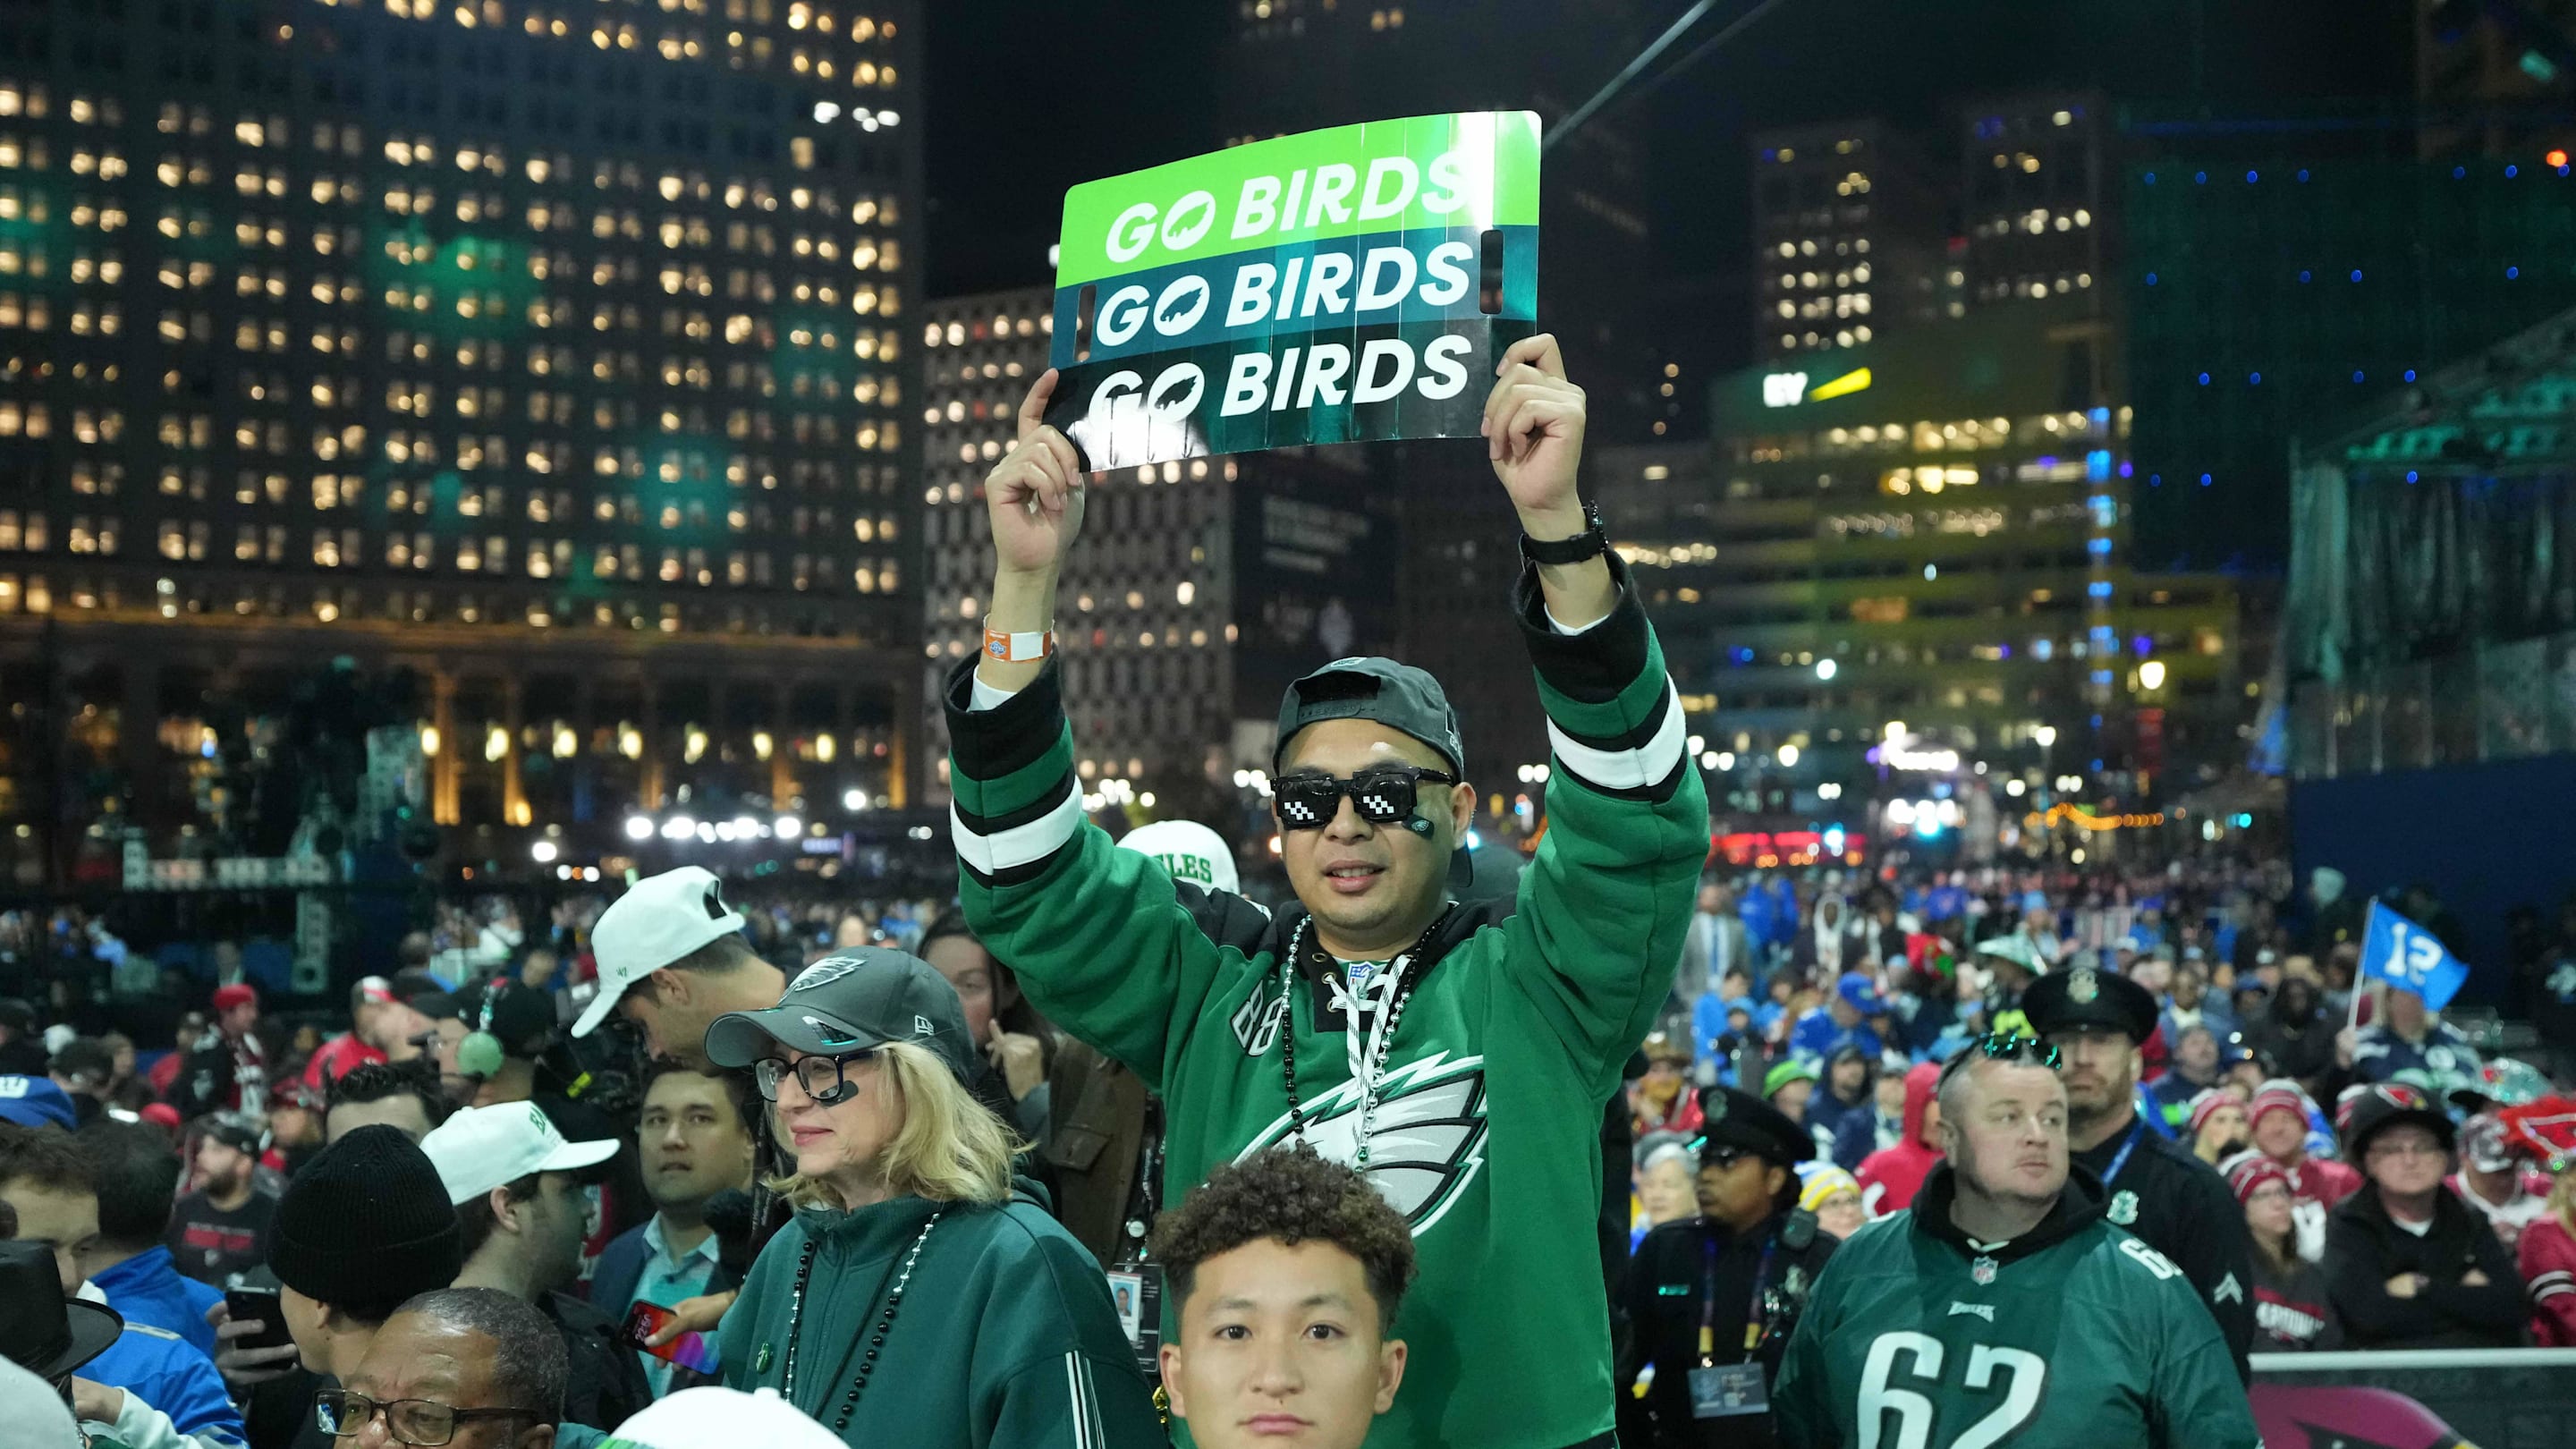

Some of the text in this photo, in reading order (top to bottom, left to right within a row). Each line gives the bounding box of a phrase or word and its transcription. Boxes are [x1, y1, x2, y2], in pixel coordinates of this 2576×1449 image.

[1106, 150, 1475, 263] GO BIRDS
[1096, 242, 1475, 347] GO BIRDS
[1088, 335, 1473, 434] GO BIRDS
[2118, 1238, 2184, 1280] 6
[1857, 1330, 2046, 1449] 62
